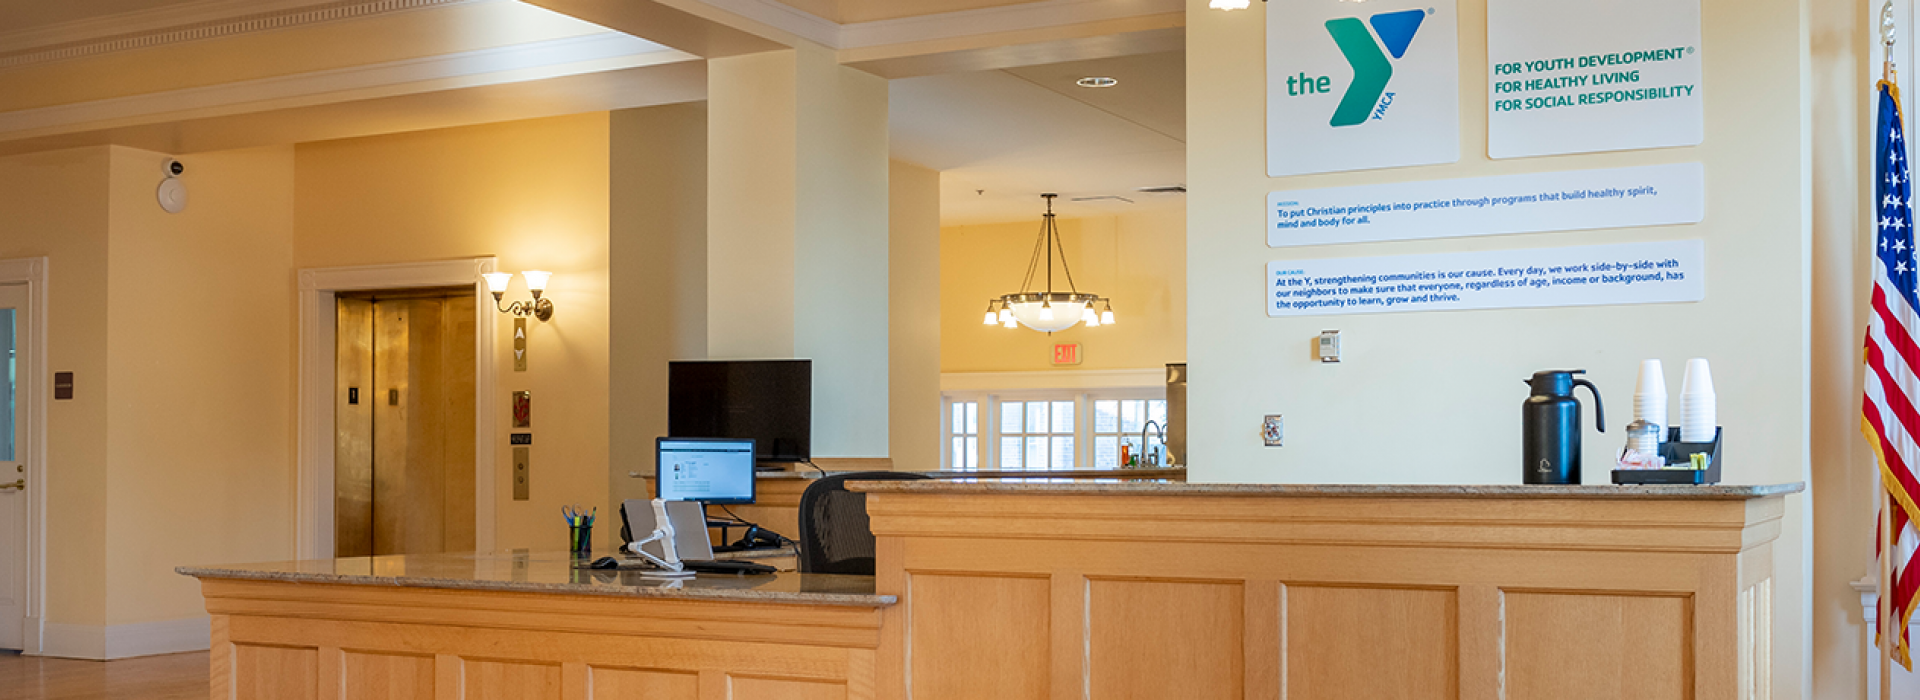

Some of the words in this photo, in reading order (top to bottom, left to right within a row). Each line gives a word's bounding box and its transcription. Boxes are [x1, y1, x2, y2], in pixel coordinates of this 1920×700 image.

[1495, 62, 1522, 75] FOR
[1525, 58, 1574, 72] YOUTH
[1286, 72, 1331, 96] the
[1495, 81, 1522, 93] FOR
[1525, 75, 1588, 91] HEALTHY
[1592, 70, 1640, 85] LIVING
[1372, 92, 1396, 121] YMCA
[1495, 99, 1522, 111] FOR
[1525, 96, 1575, 109] SOCIAL
[1578, 85, 1694, 105] RESPONSIBILITY
[1277, 209, 1288, 218] To
[1290, 209, 1305, 219] put
[1306, 206, 1346, 216] Christian
[1348, 203, 1391, 214] principles
[1393, 202, 1411, 210] into
[1413, 200, 1450, 209] practice
[1452, 196, 1490, 207] through
[1491, 194, 1537, 206] programs
[1539, 192, 1559, 201] that
[1561, 190, 1586, 200] build
[1588, 188, 1625, 198] healthy
[1277, 220, 1299, 228] mind
[1300, 218, 1316, 227] and
[1318, 217, 1340, 227] body
[1342, 216, 1355, 225] for
[1276, 278, 1286, 286] At
[1288, 278, 1303, 286] the
[1314, 274, 1377, 285] strengthening
[1379, 272, 1436, 281] communities
[1438, 270, 1446, 279] is
[1447, 271, 1464, 279] our
[1498, 267, 1524, 277] Every
[1564, 263, 1589, 273] work
[1656, 259, 1679, 268] with
[1293, 287, 1336, 298] neighbors
[1338, 286, 1348, 295] to
[1350, 285, 1373, 294] make
[1376, 284, 1395, 293] sure
[1397, 283, 1416, 292] that
[1465, 279, 1516, 292] regardless
[1517, 278, 1528, 286] of
[1552, 275, 1587, 285] income
[1666, 271, 1684, 280] has
[1276, 300, 1291, 308] the
[1293, 297, 1345, 309] opportunity
[1347, 297, 1357, 305] to
[1387, 296, 1409, 305] grow
[1411, 294, 1428, 303] and
[1055, 344, 1077, 362] EXIT
